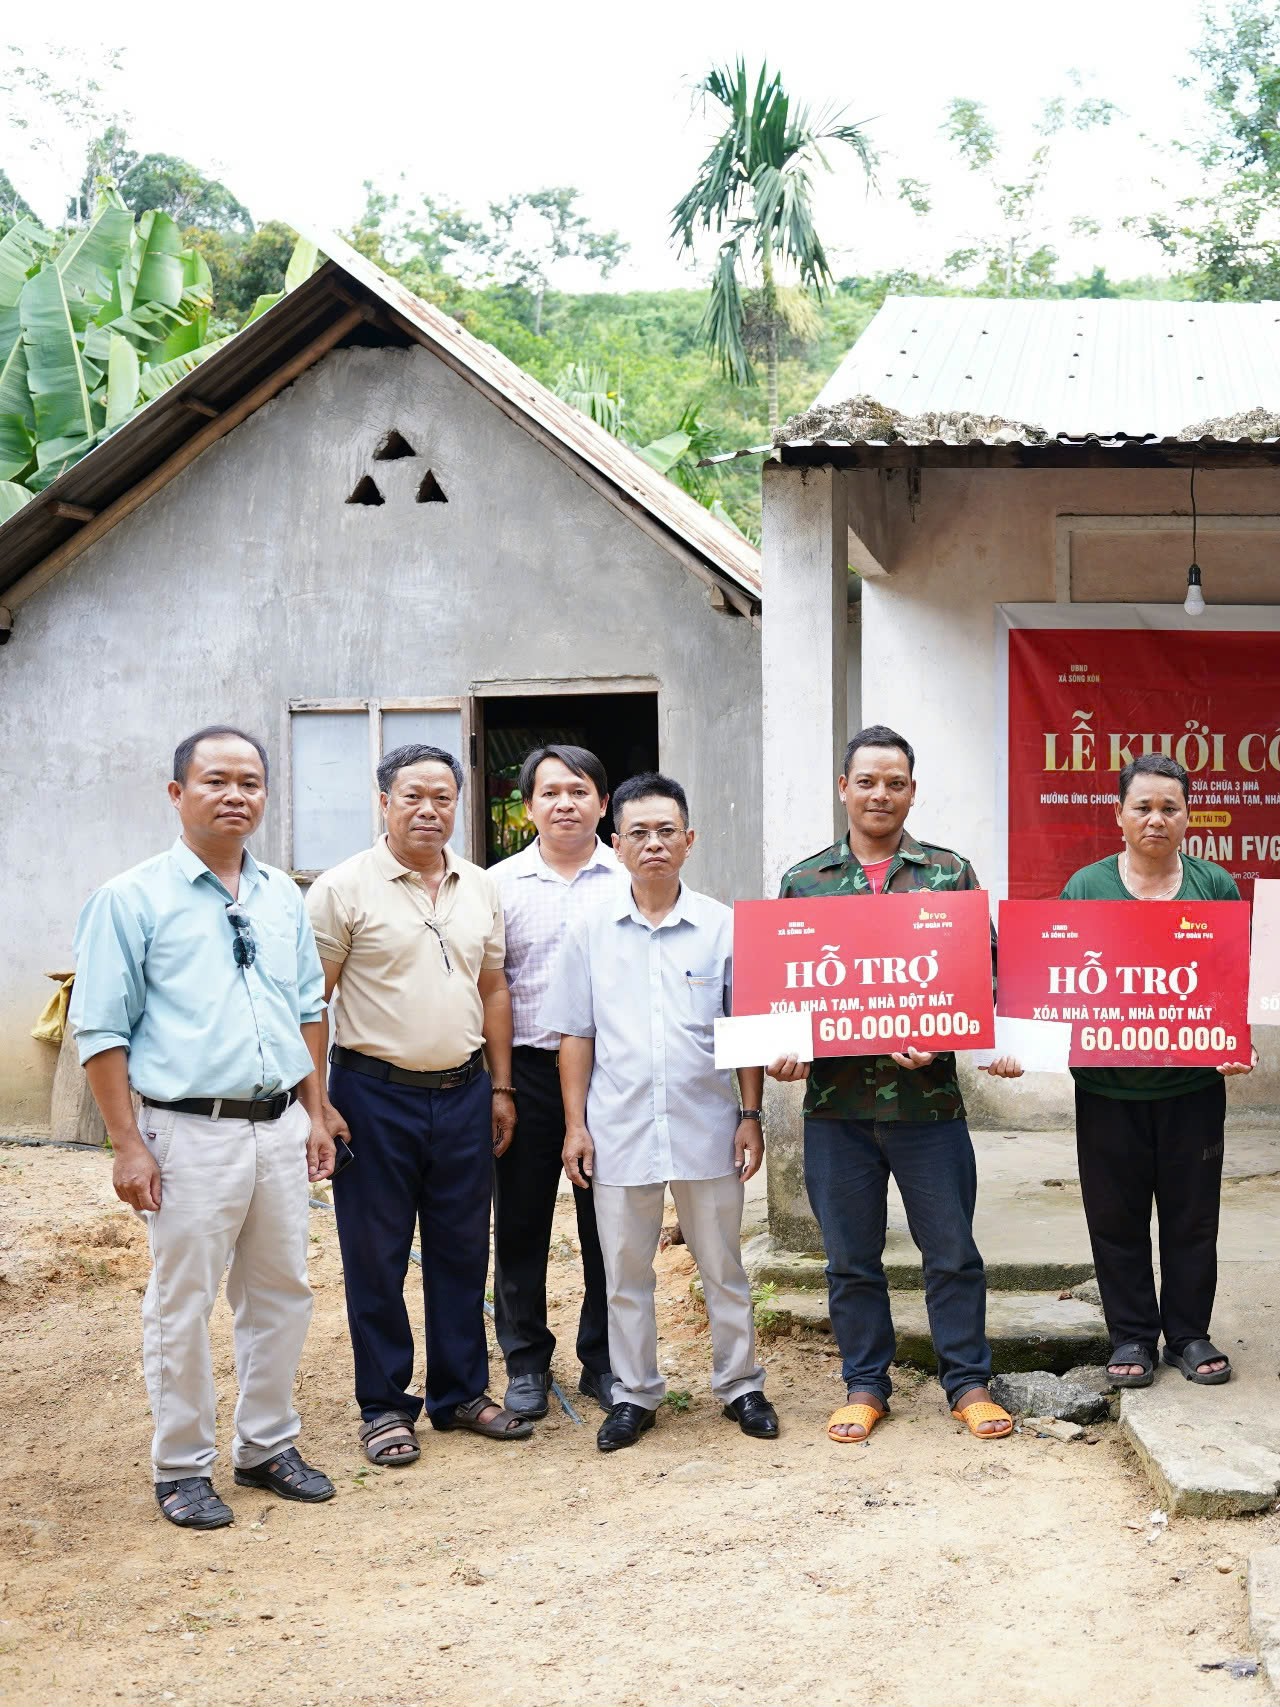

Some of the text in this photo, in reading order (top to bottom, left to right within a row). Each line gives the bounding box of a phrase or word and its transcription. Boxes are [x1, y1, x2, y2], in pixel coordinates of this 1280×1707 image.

[1043, 709, 1096, 772] LỄ
[1107, 719, 1227, 772] KHỞI
[1191, 778, 1260, 791] SỬA CHỮA 3 NHÀ
[1071, 791, 1088, 804] ỨNG
[1188, 794, 1203, 805] TAY
[1205, 792, 1222, 805] XÓA
[1223, 792, 1240, 805] NHÀ
[1242, 794, 1263, 806] TẠM,
[784, 944, 939, 989] HỖ TRỢ
[1047, 950, 1199, 1001] HỖ TRỢ
[770, 990, 955, 1014] XÓA NHÀ TẠM, NHÀ DỘT NÁT
[1260, 991, 1280, 1011] SỐ
[1032, 1004, 1214, 1023] XÓA NHÀ TẠM, NHÀ DỘT NÁT
